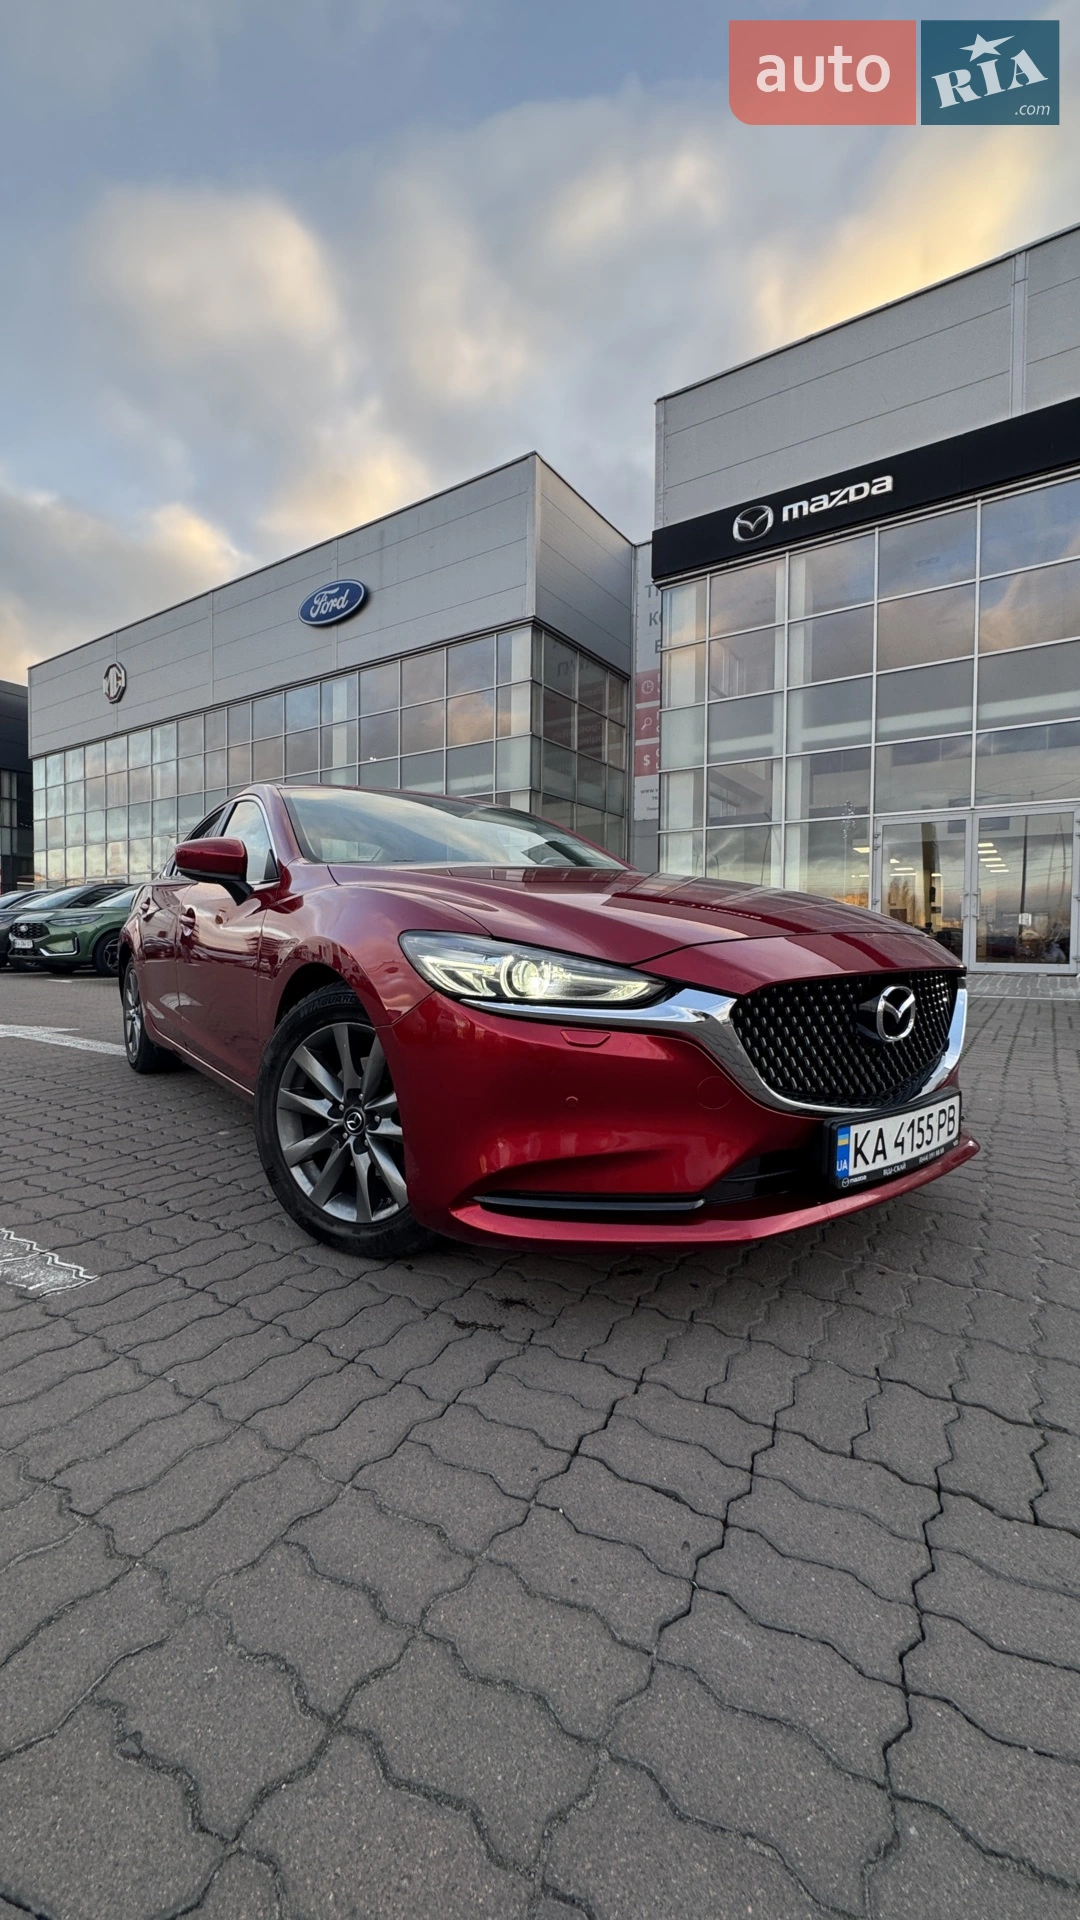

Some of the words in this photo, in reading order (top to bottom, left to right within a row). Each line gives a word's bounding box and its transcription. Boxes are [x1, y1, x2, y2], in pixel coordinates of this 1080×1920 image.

[782, 475, 893, 522] mazda
[309, 586, 350, 618] Ford
[853, 1128, 888, 1168] KA
[894, 1113, 934, 1155] 4155
[937, 1104, 956, 1142] PB
[836, 1159, 848, 1171] UA
